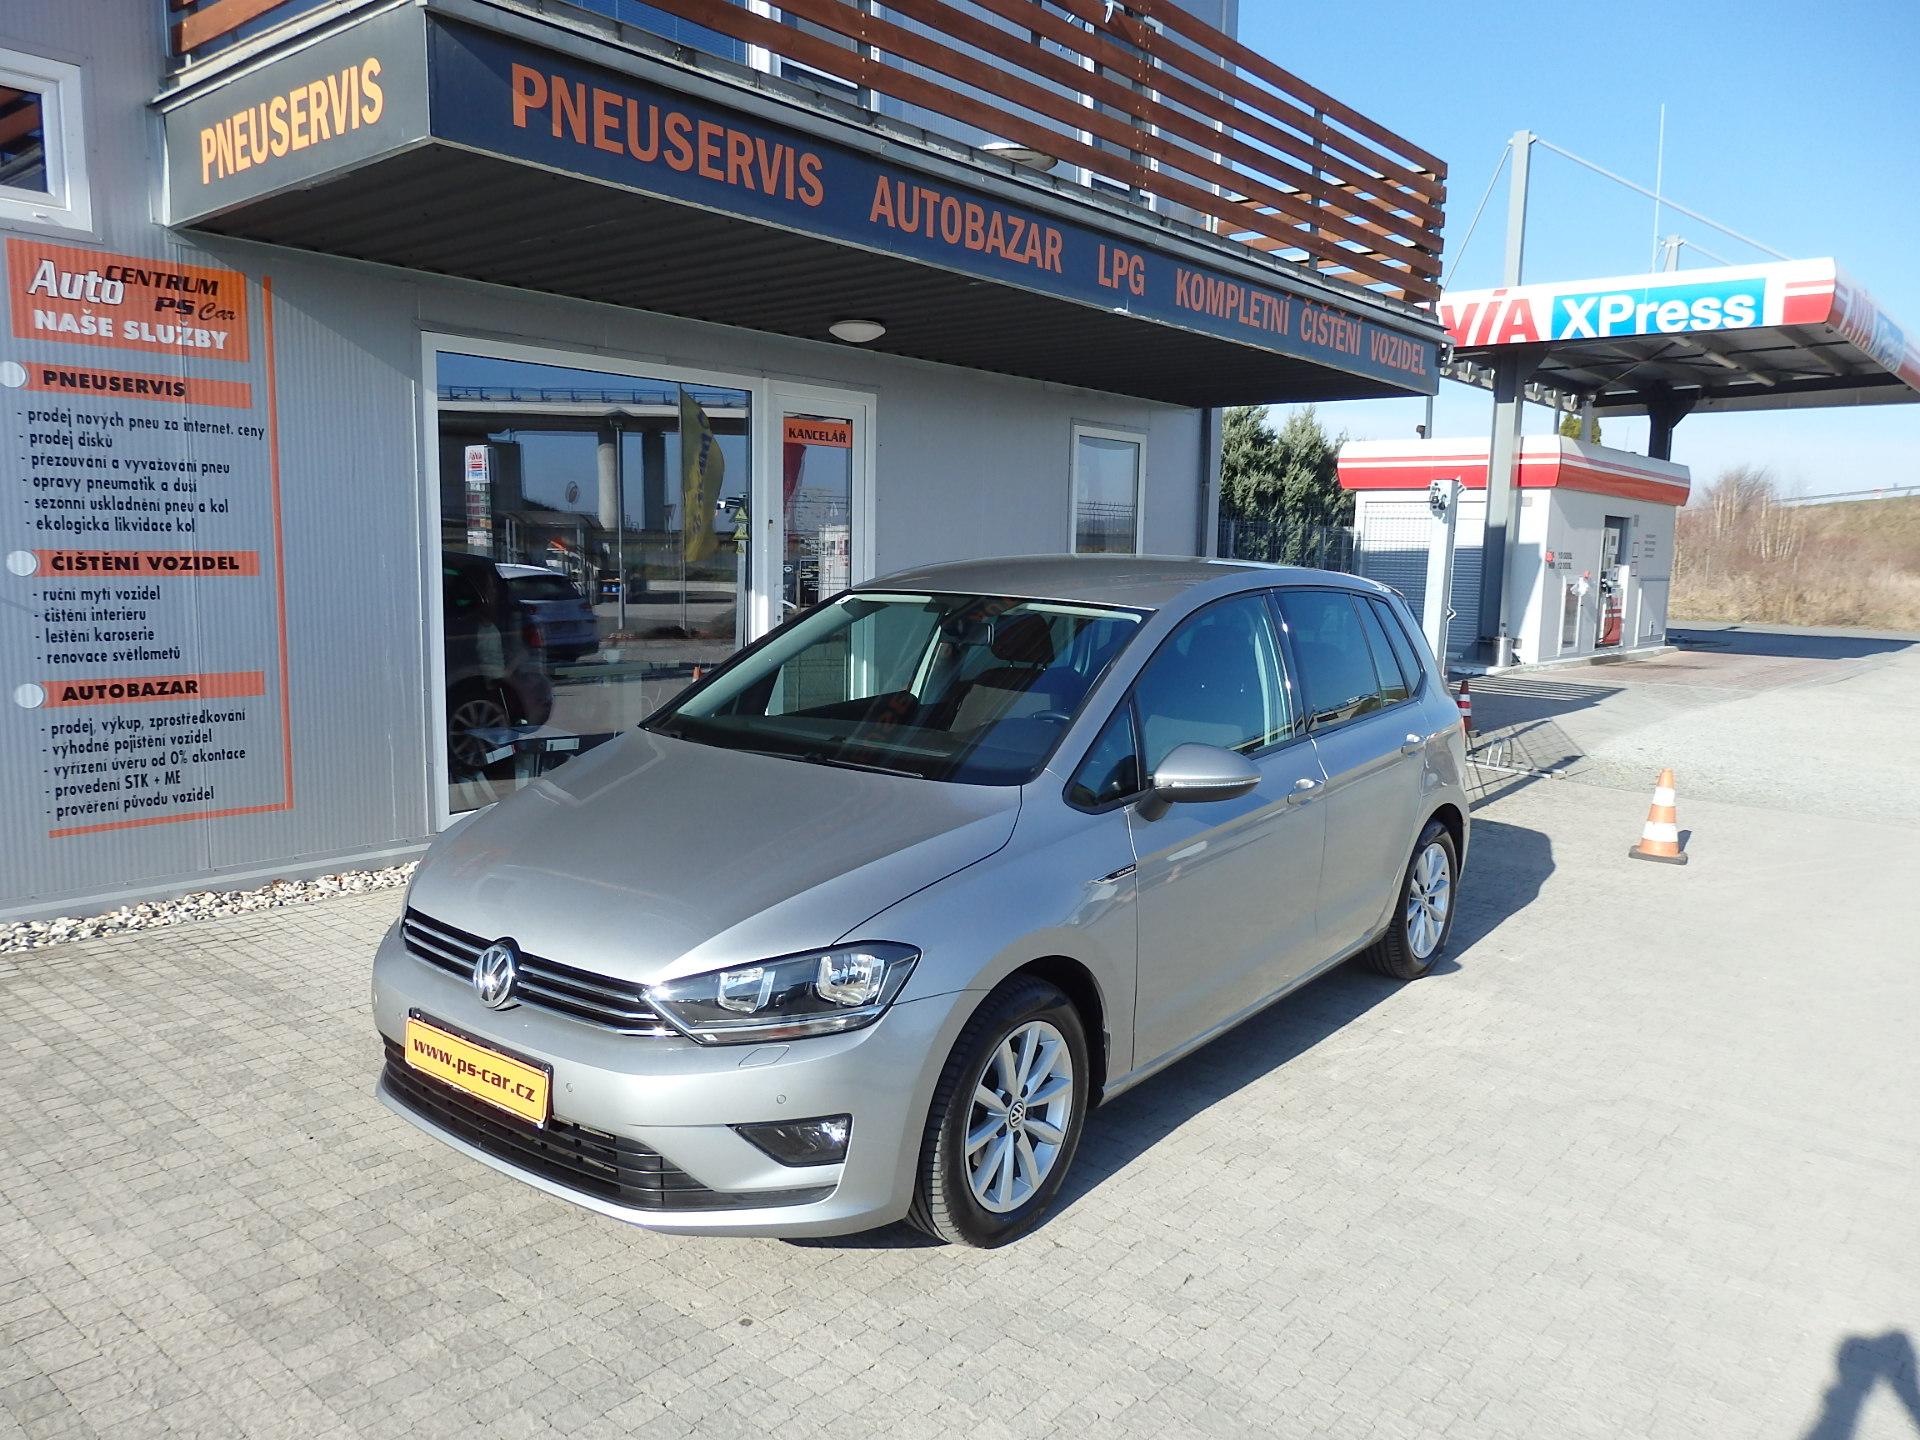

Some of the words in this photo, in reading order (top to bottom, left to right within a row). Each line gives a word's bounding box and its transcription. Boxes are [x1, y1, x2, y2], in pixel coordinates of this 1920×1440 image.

[200, 57, 384, 185] PNEUSERVIS
[511, 62, 825, 207] PNEUSERVIS
[869, 175, 1064, 274] AUTOBAZAR
[1097, 244, 1146, 297] LPG
[1175, 266, 1292, 336] KOMPLETNÍ
[1299, 299, 1363, 356] ČIŠTĚNÍ
[1370, 329, 1426, 377] VOZIDEL
[26, 257, 125, 305] Auto
[105, 265, 219, 296] CENTRUM
[154, 296, 196, 316] PS
[198, 302, 237, 321] Car
[1558, 294, 1756, 340] XPress
[33, 308, 114, 338] NAŠE
[122, 319, 229, 350] SLUŽBY
[43, 370, 186, 397] PNEUSERVIS
[28, 407, 72, 427] prodej
[128, 417, 159, 431] pneu
[164, 420, 179, 431] za
[238, 426, 264, 440] ceny
[29, 429, 73, 450] prodej
[788, 427, 847, 444] KANCELÁŘ
[111, 459, 119, 469] a
[201, 463, 230, 476] pneu
[33, 476, 81, 493] opravy
[87, 476, 156, 493] pneumatik
[161, 481, 168, 492] a
[165, 501, 194, 515] pneu
[198, 502, 206, 513] a
[210, 498, 229, 513] kol
[115, 516, 172, 532] likvidace
[176, 517, 195, 533] kol
[51, 552, 139, 571] ČIŠTĚNÍ
[146, 556, 240, 571] VOZIDEL
[115, 585, 161, 601] vozidel
[94, 626, 155, 642] karoserie
[47, 652, 108, 664] renovace
[62, 681, 199, 701] AUTOBAZAR
[170, 728, 212, 745] vozidel
[151, 752, 166, 767] od
[170, 749, 188, 765] 0%
[192, 749, 246, 763] akontace
[125, 773, 149, 789] STK
[164, 770, 181, 785] ME
[124, 792, 168, 813] původu
[172, 785, 214, 802] vozidel
[413, 1038, 536, 1103] www.ps-car.cz
